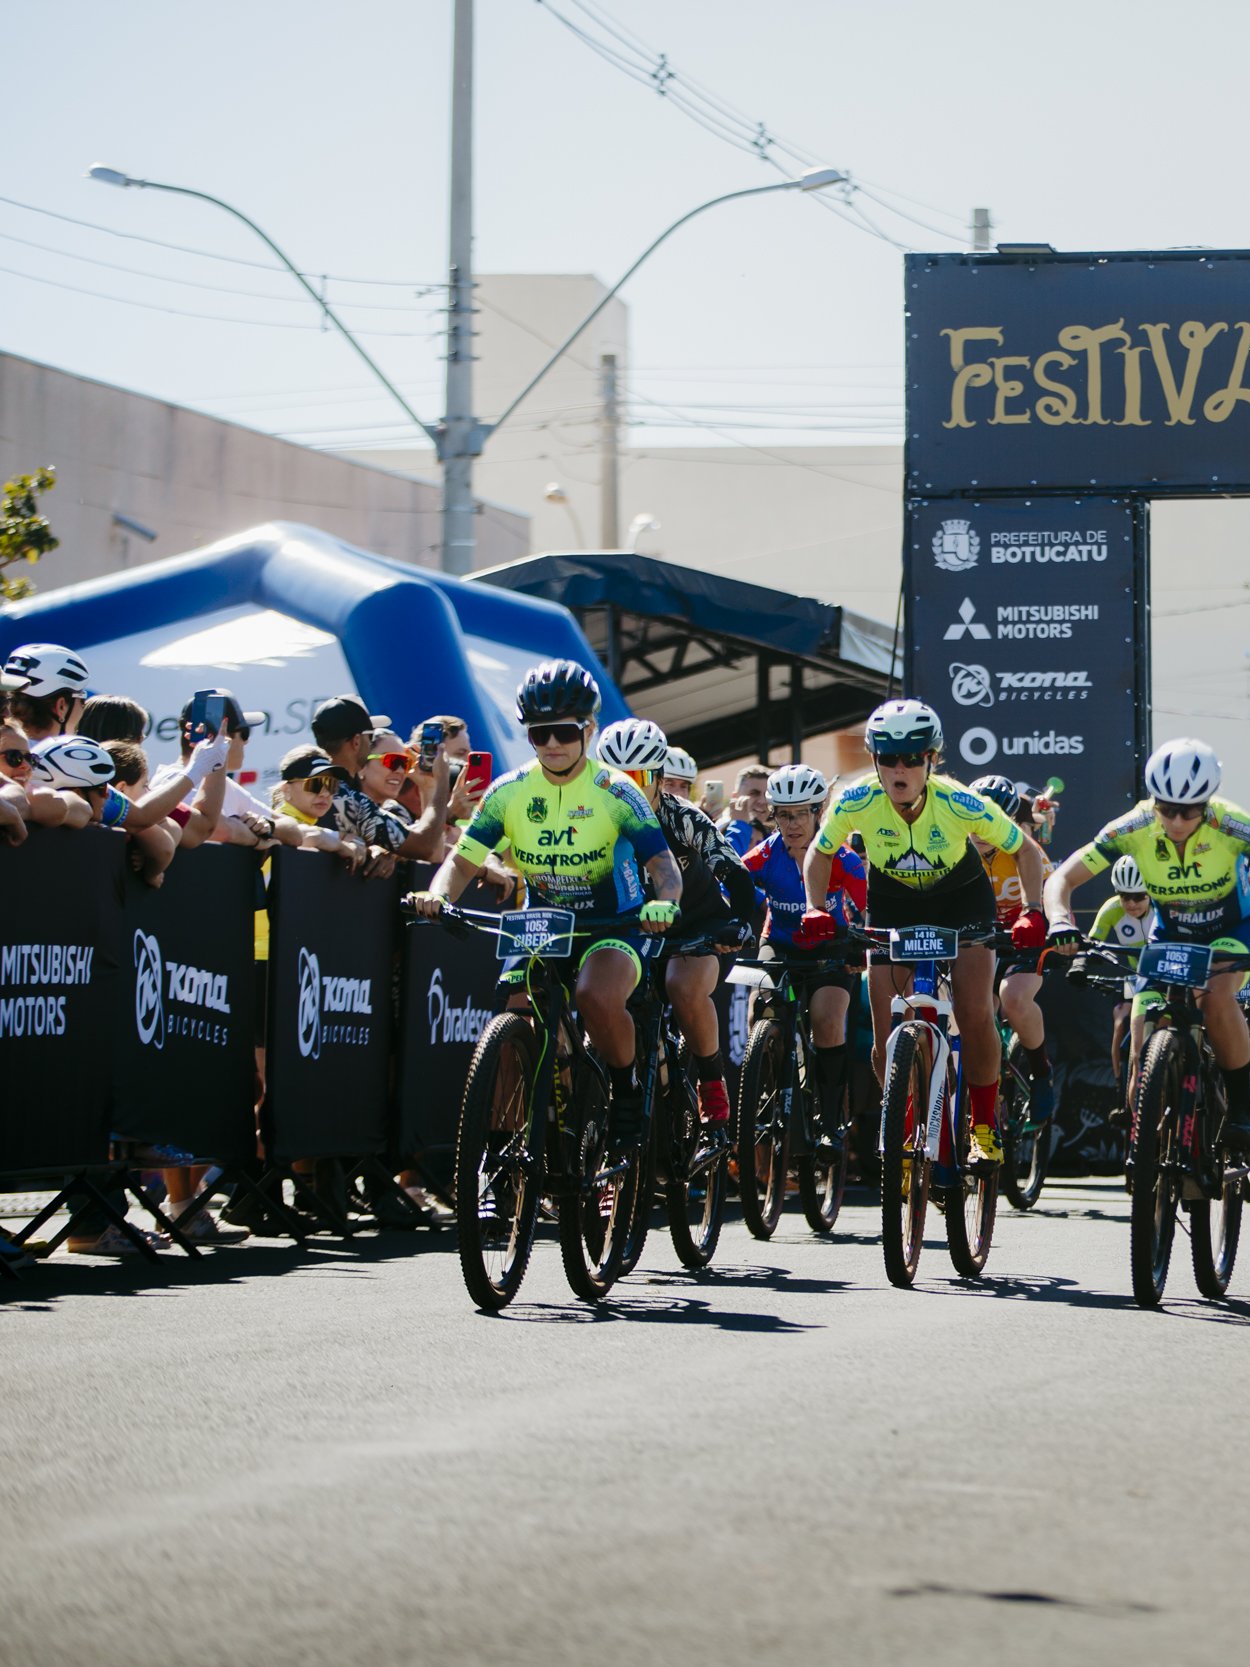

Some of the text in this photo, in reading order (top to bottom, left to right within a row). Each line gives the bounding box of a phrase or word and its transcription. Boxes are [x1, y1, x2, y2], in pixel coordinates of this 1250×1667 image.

[990, 530, 1108, 545] PREFEITURA DE
[990, 545, 1108, 564] BOTUCATU
[996, 605, 1099, 621] MITSUBISHI
[996, 623, 1073, 640] MOTORS
[998, 690, 1089, 701] BICYCLES
[1002, 730, 1085, 755] unidas
[537, 825, 576, 847] avt
[514, 846, 607, 867] VERSATRONIC
[1168, 862, 1202, 880] avt
[1145, 871, 1232, 896] VERSATRONIC
[1169, 907, 1225, 924] PIRALUX
[525, 920, 549, 933] 1052
[915, 931, 936, 939] 1416
[904, 939, 944, 952] MILENE
[1, 944, 94, 985] MITSUBISHI
[1166, 951, 1189, 963] 1053
[0, 995, 67, 1038] MOTORS
[168, 1014, 228, 1046] BICYCLES
[322, 1025, 371, 1046] BICYCLES
